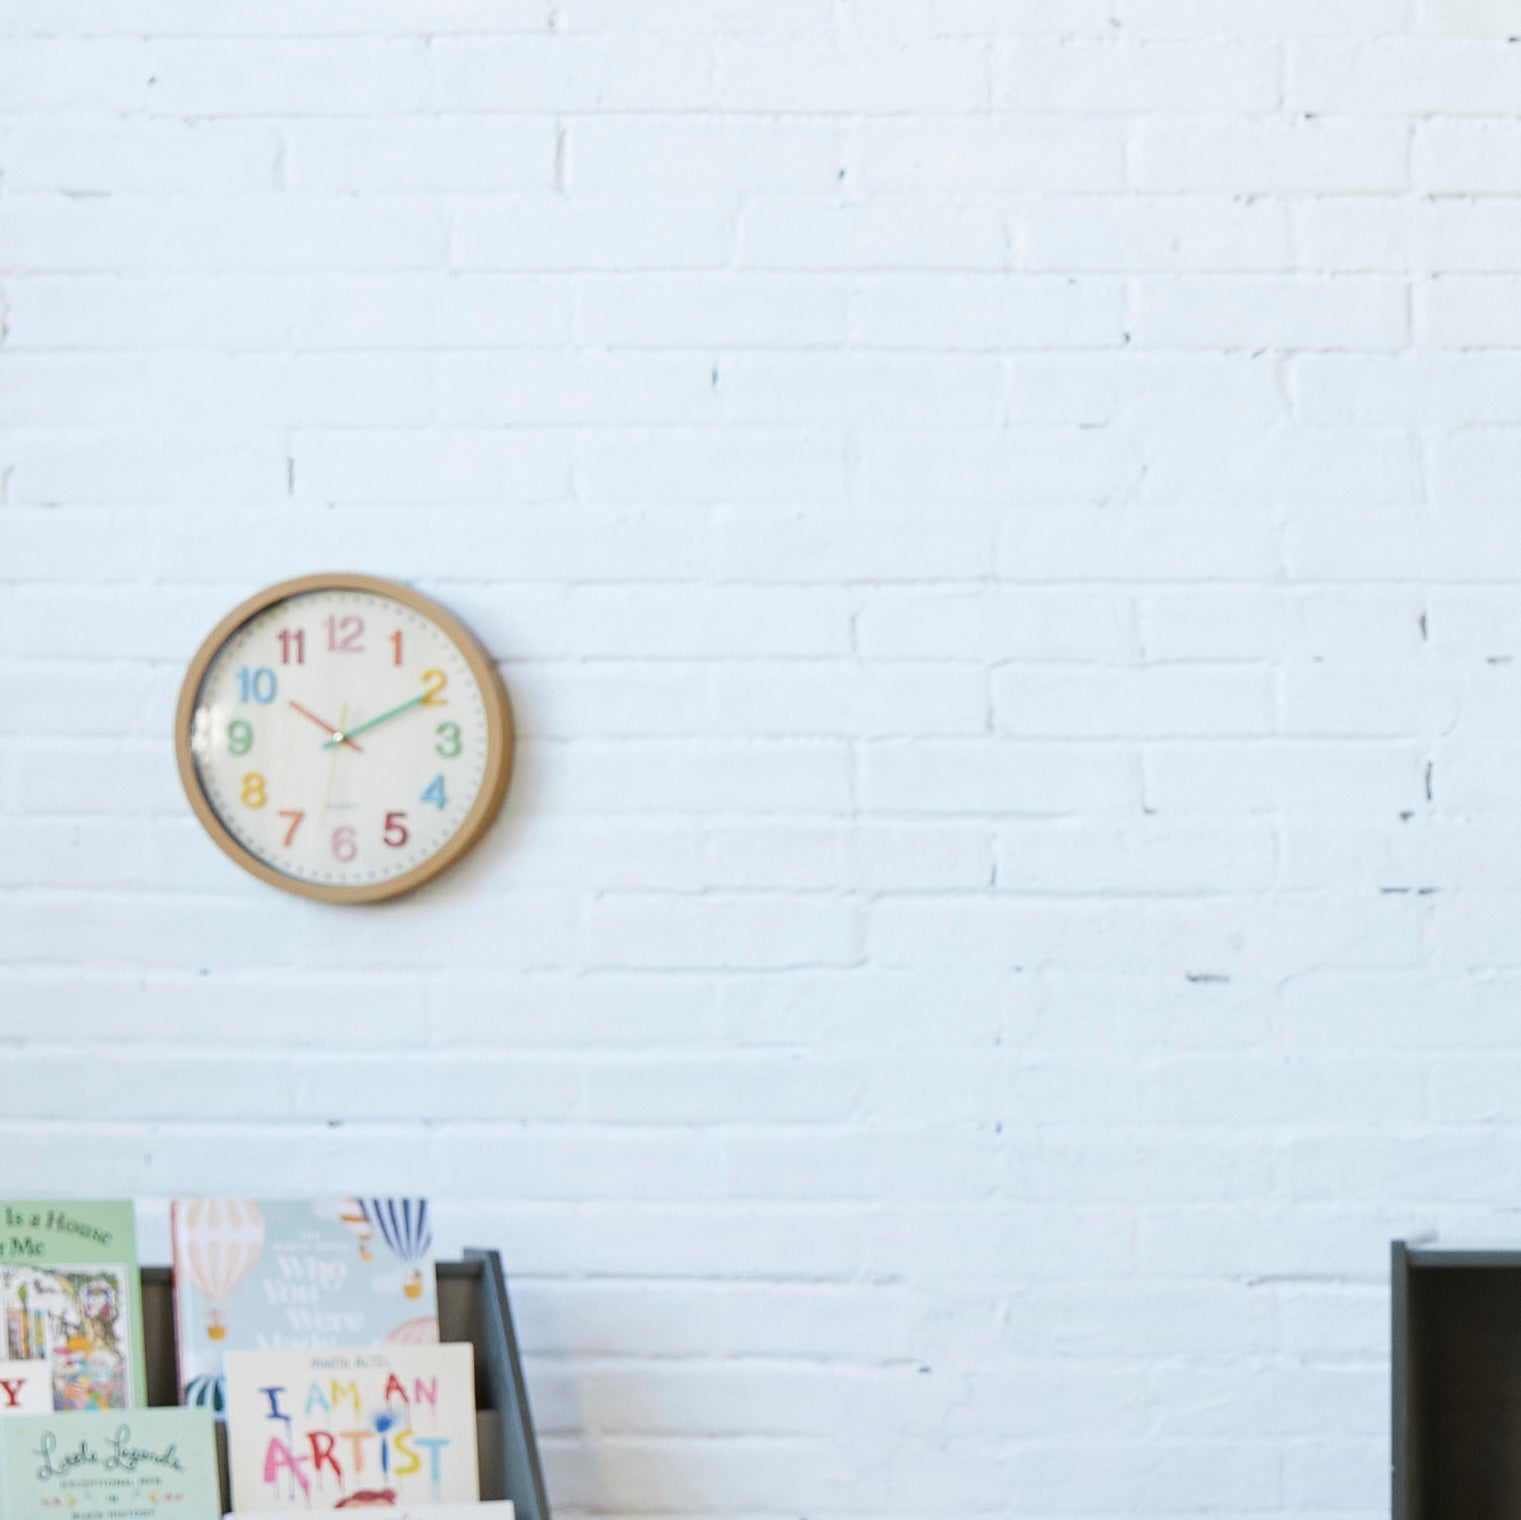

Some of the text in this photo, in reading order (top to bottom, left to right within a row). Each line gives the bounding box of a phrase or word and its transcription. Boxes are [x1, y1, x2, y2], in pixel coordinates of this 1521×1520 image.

[278, 629, 305, 665] 11
[325, 615, 365, 652] 12
[389, 629, 402, 666] 1
[236, 667, 277, 704] 10
[420, 668, 447, 706] 2
[227, 719, 252, 756] 9
[435, 722, 462, 758] 3
[240, 772, 266, 809] 8
[419, 773, 448, 810] 4
[278, 809, 304, 847] 7
[331, 826, 358, 862] 6
[383, 812, 408, 848] 5
[9, 1236, 47, 1256] Me
[30, 1213, 42, 1228] a
[46, 1208, 114, 1247] House
[259, 1371, 438, 1421] I AM AN
